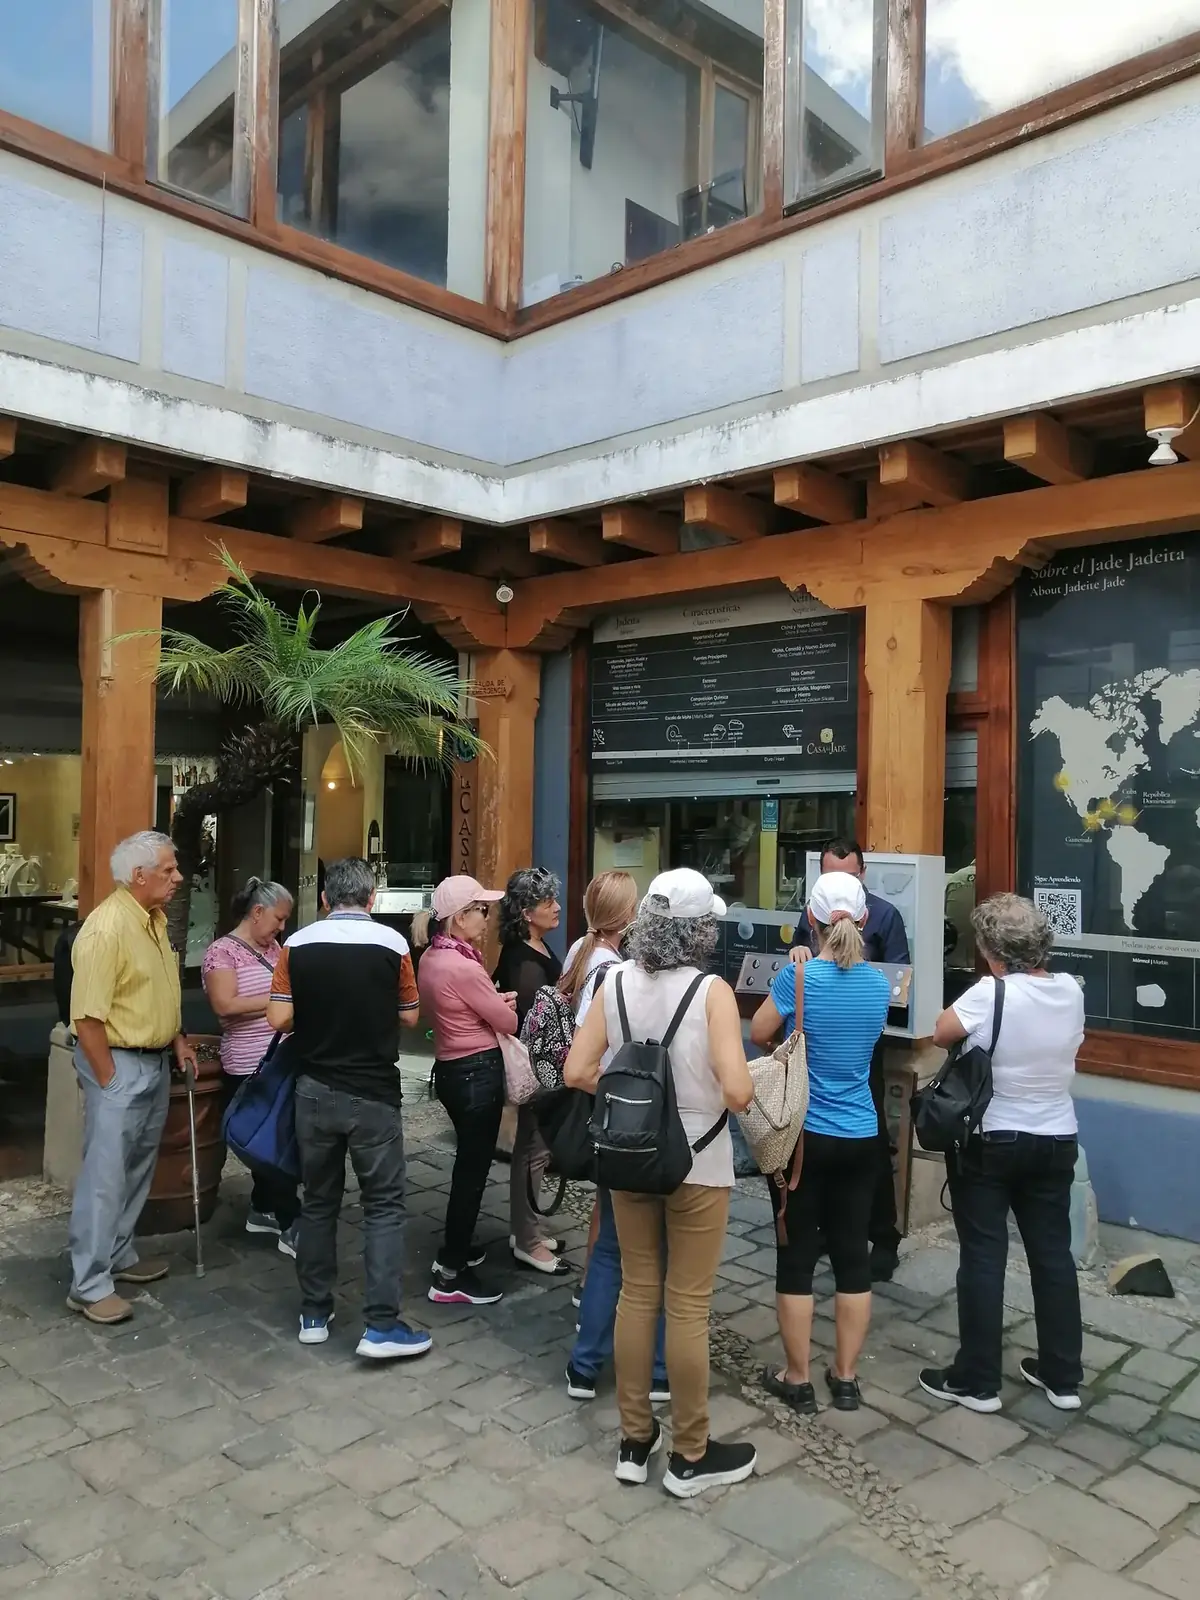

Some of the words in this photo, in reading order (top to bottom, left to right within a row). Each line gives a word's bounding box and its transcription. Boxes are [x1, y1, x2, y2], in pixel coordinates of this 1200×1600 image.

[1030, 562, 1069, 580] Sobre
[1073, 558, 1085, 574] el
[1088, 554, 1123, 577] Jade
[1126, 548, 1185, 572] Jadeita
[1030, 583, 1061, 597] About
[1063, 579, 1100, 596] Jadeite
[1102, 575, 1126, 591] Jade
[459, 792, 472, 876] CASA
